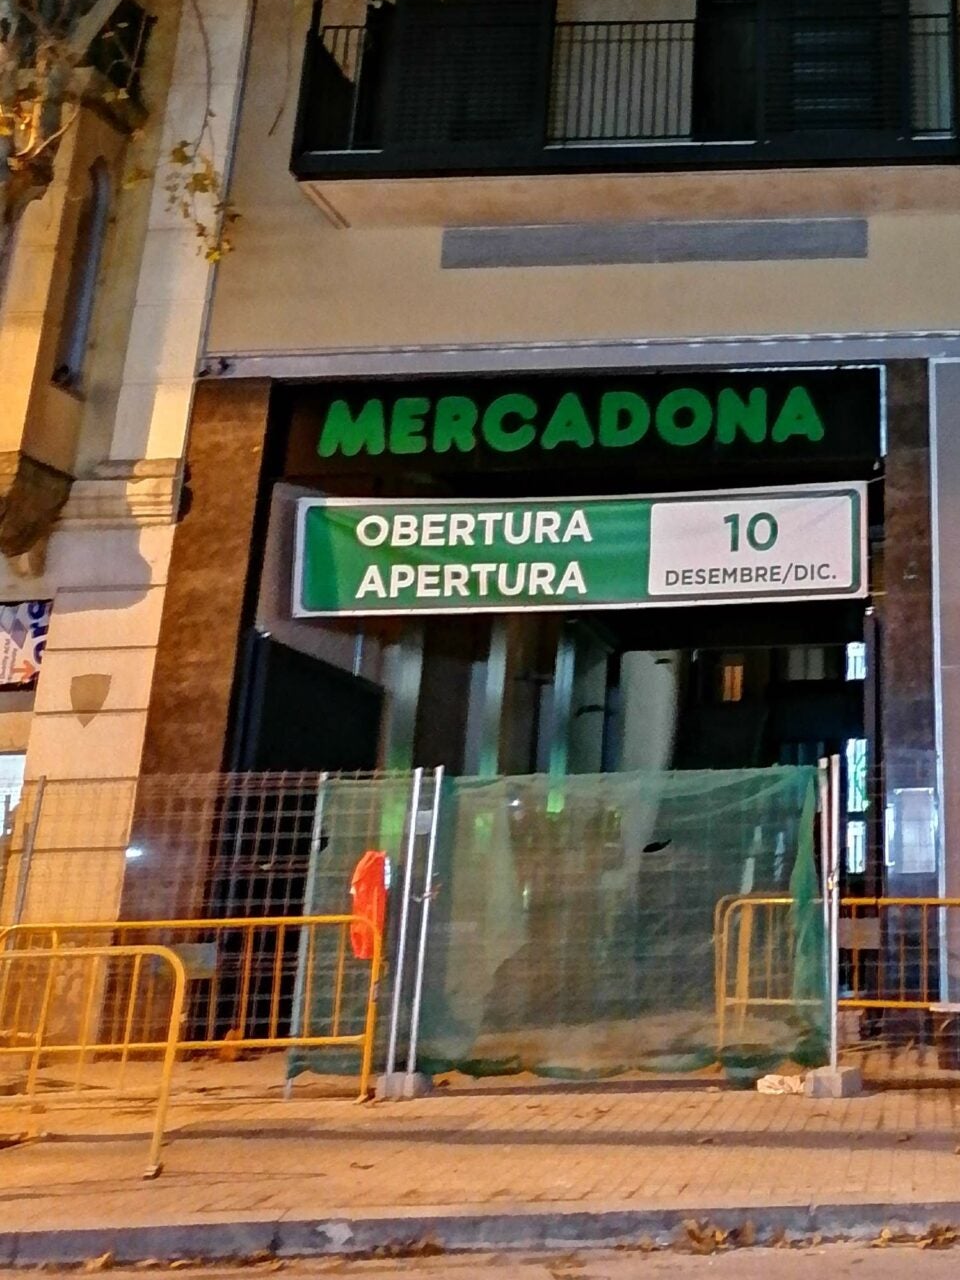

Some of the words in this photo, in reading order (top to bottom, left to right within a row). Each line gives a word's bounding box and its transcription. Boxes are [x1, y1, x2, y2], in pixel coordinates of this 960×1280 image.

[317, 385, 825, 458] MERCADONA
[356, 510, 593, 547] OBERTURA
[723, 512, 778, 552] 10
[355, 561, 587, 599] APERTURA
[665, 563, 837, 587] DESEMBRE/DIC.
